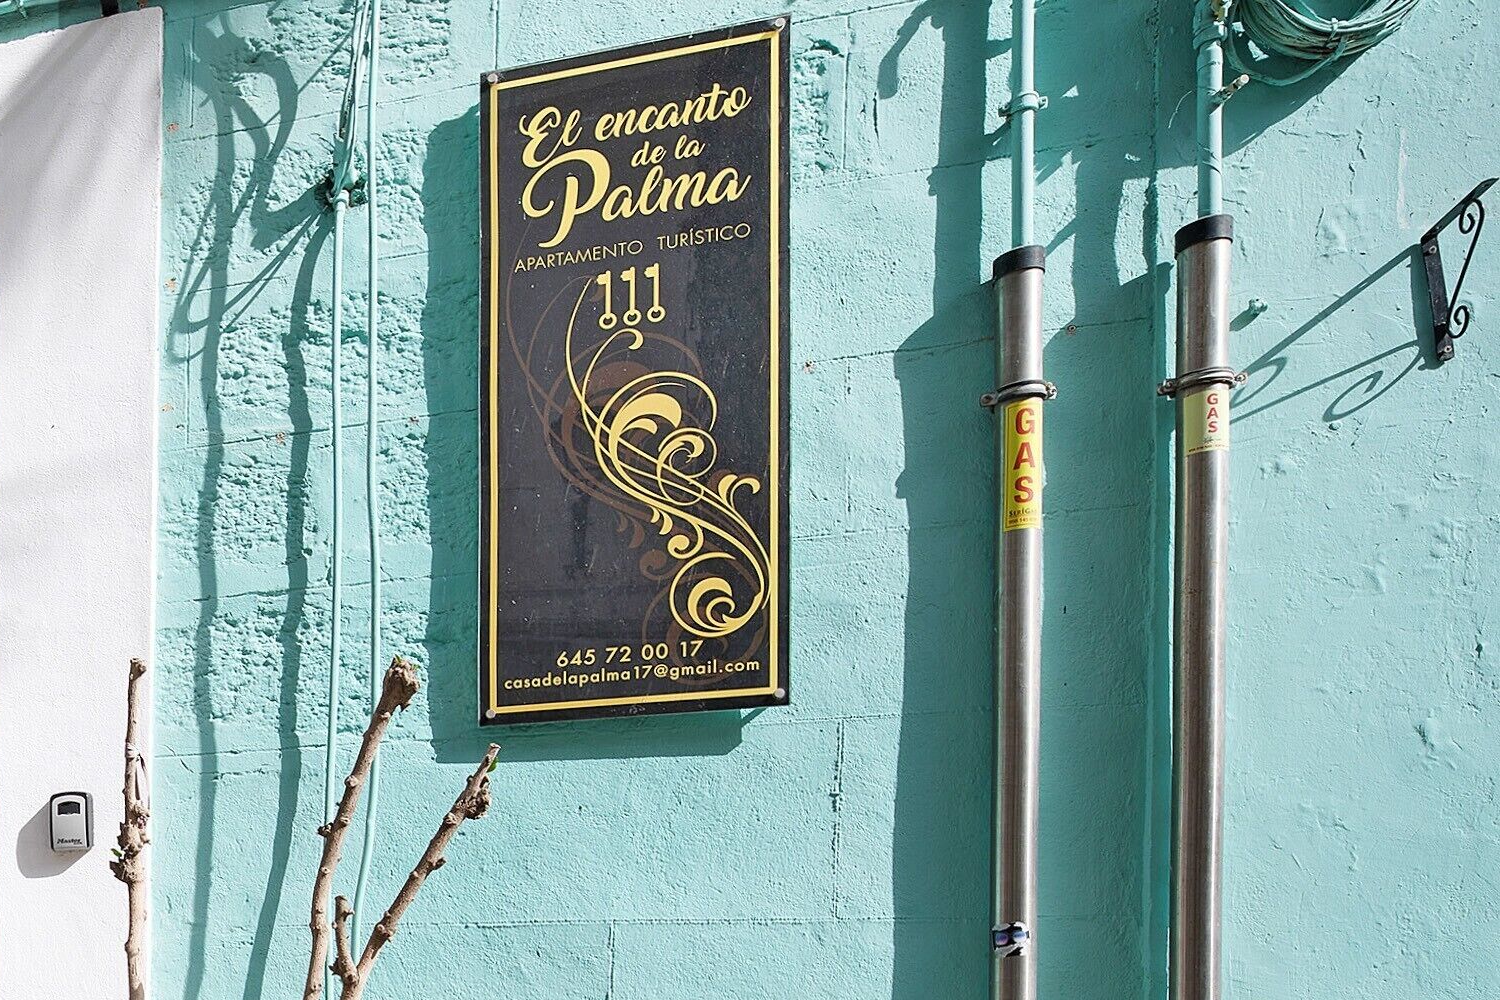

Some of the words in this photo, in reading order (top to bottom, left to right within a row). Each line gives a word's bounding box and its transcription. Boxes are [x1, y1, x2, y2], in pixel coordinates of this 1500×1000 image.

[519, 106, 583, 168] El
[594, 83, 752, 142] encanto
[631, 141, 667, 168] de
[674, 135, 706, 160] la
[521, 149, 752, 248] Palma
[514, 239, 644, 273] APARTAMENTO
[656, 222, 751, 251] TURÍSTICO
[1206, 393, 1219, 433] GAS
[1013, 407, 1036, 504] GAS
[504, 659, 760, 690] casadelapalma17@gmail.com
[556, 647, 596, 668] 645
[605, 645, 632, 664] 72
[640, 643, 670, 661] 00
[680, 640, 705, 658] 17
